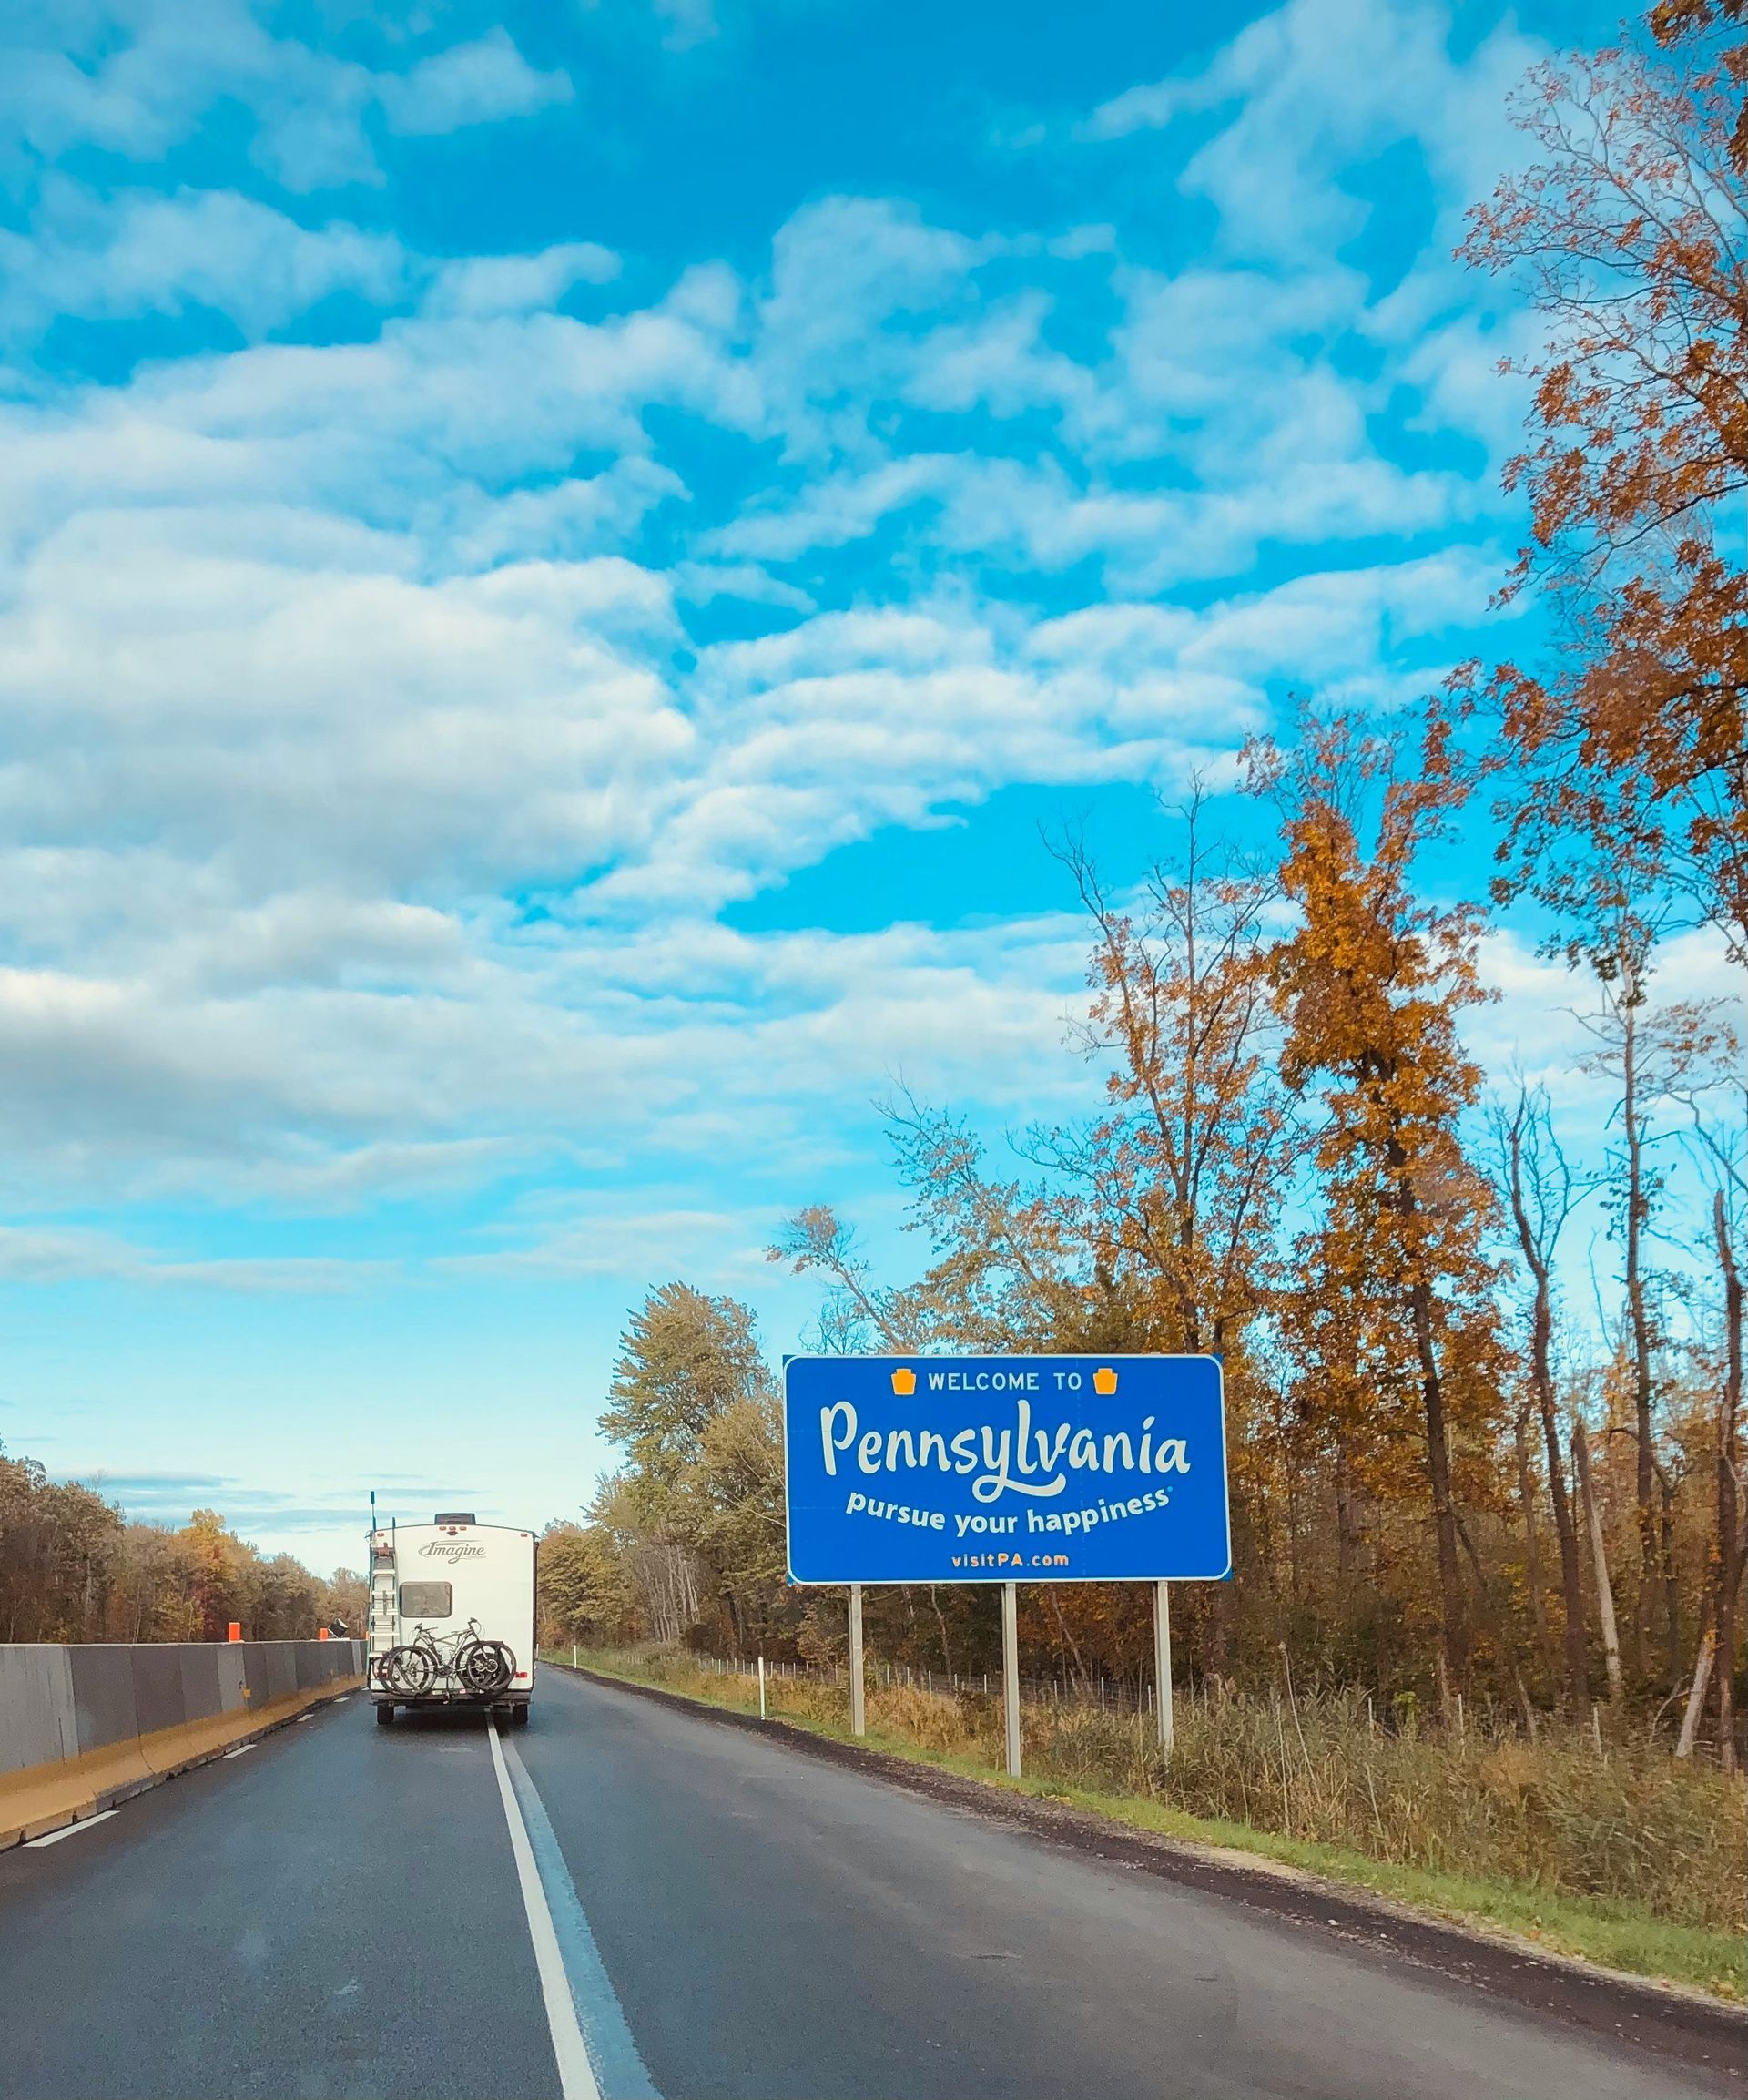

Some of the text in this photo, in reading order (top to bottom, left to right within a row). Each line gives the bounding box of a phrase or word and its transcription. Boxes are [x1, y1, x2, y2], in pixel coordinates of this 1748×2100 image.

[928, 1372, 1082, 1391] WELCOME TO
[820, 1400, 1191, 1503] Pennsylvania
[846, 1489, 1170, 1537] pursue your happiness
[425, 1541, 485, 1564] Imagine
[951, 1553, 1069, 1567] visitPA.com
